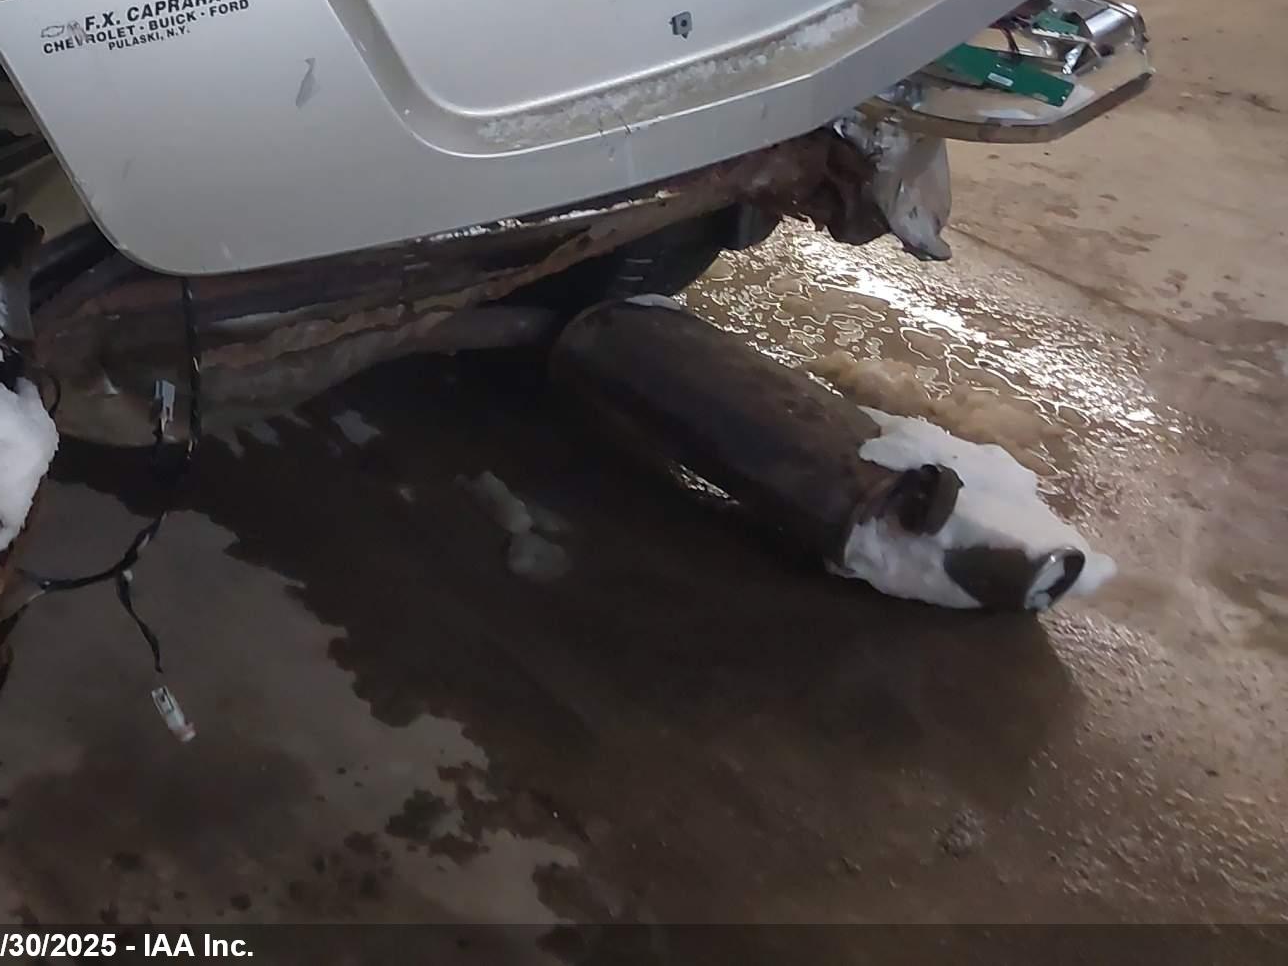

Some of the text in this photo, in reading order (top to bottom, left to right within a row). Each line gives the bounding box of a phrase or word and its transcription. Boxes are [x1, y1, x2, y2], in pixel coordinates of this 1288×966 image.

[84, 11, 121, 32] F.X.
[42, 24, 135, 55] CHEVROLET
[148, 10, 198, 31] BUICK
[108, 32, 164, 51] PULASKI,
